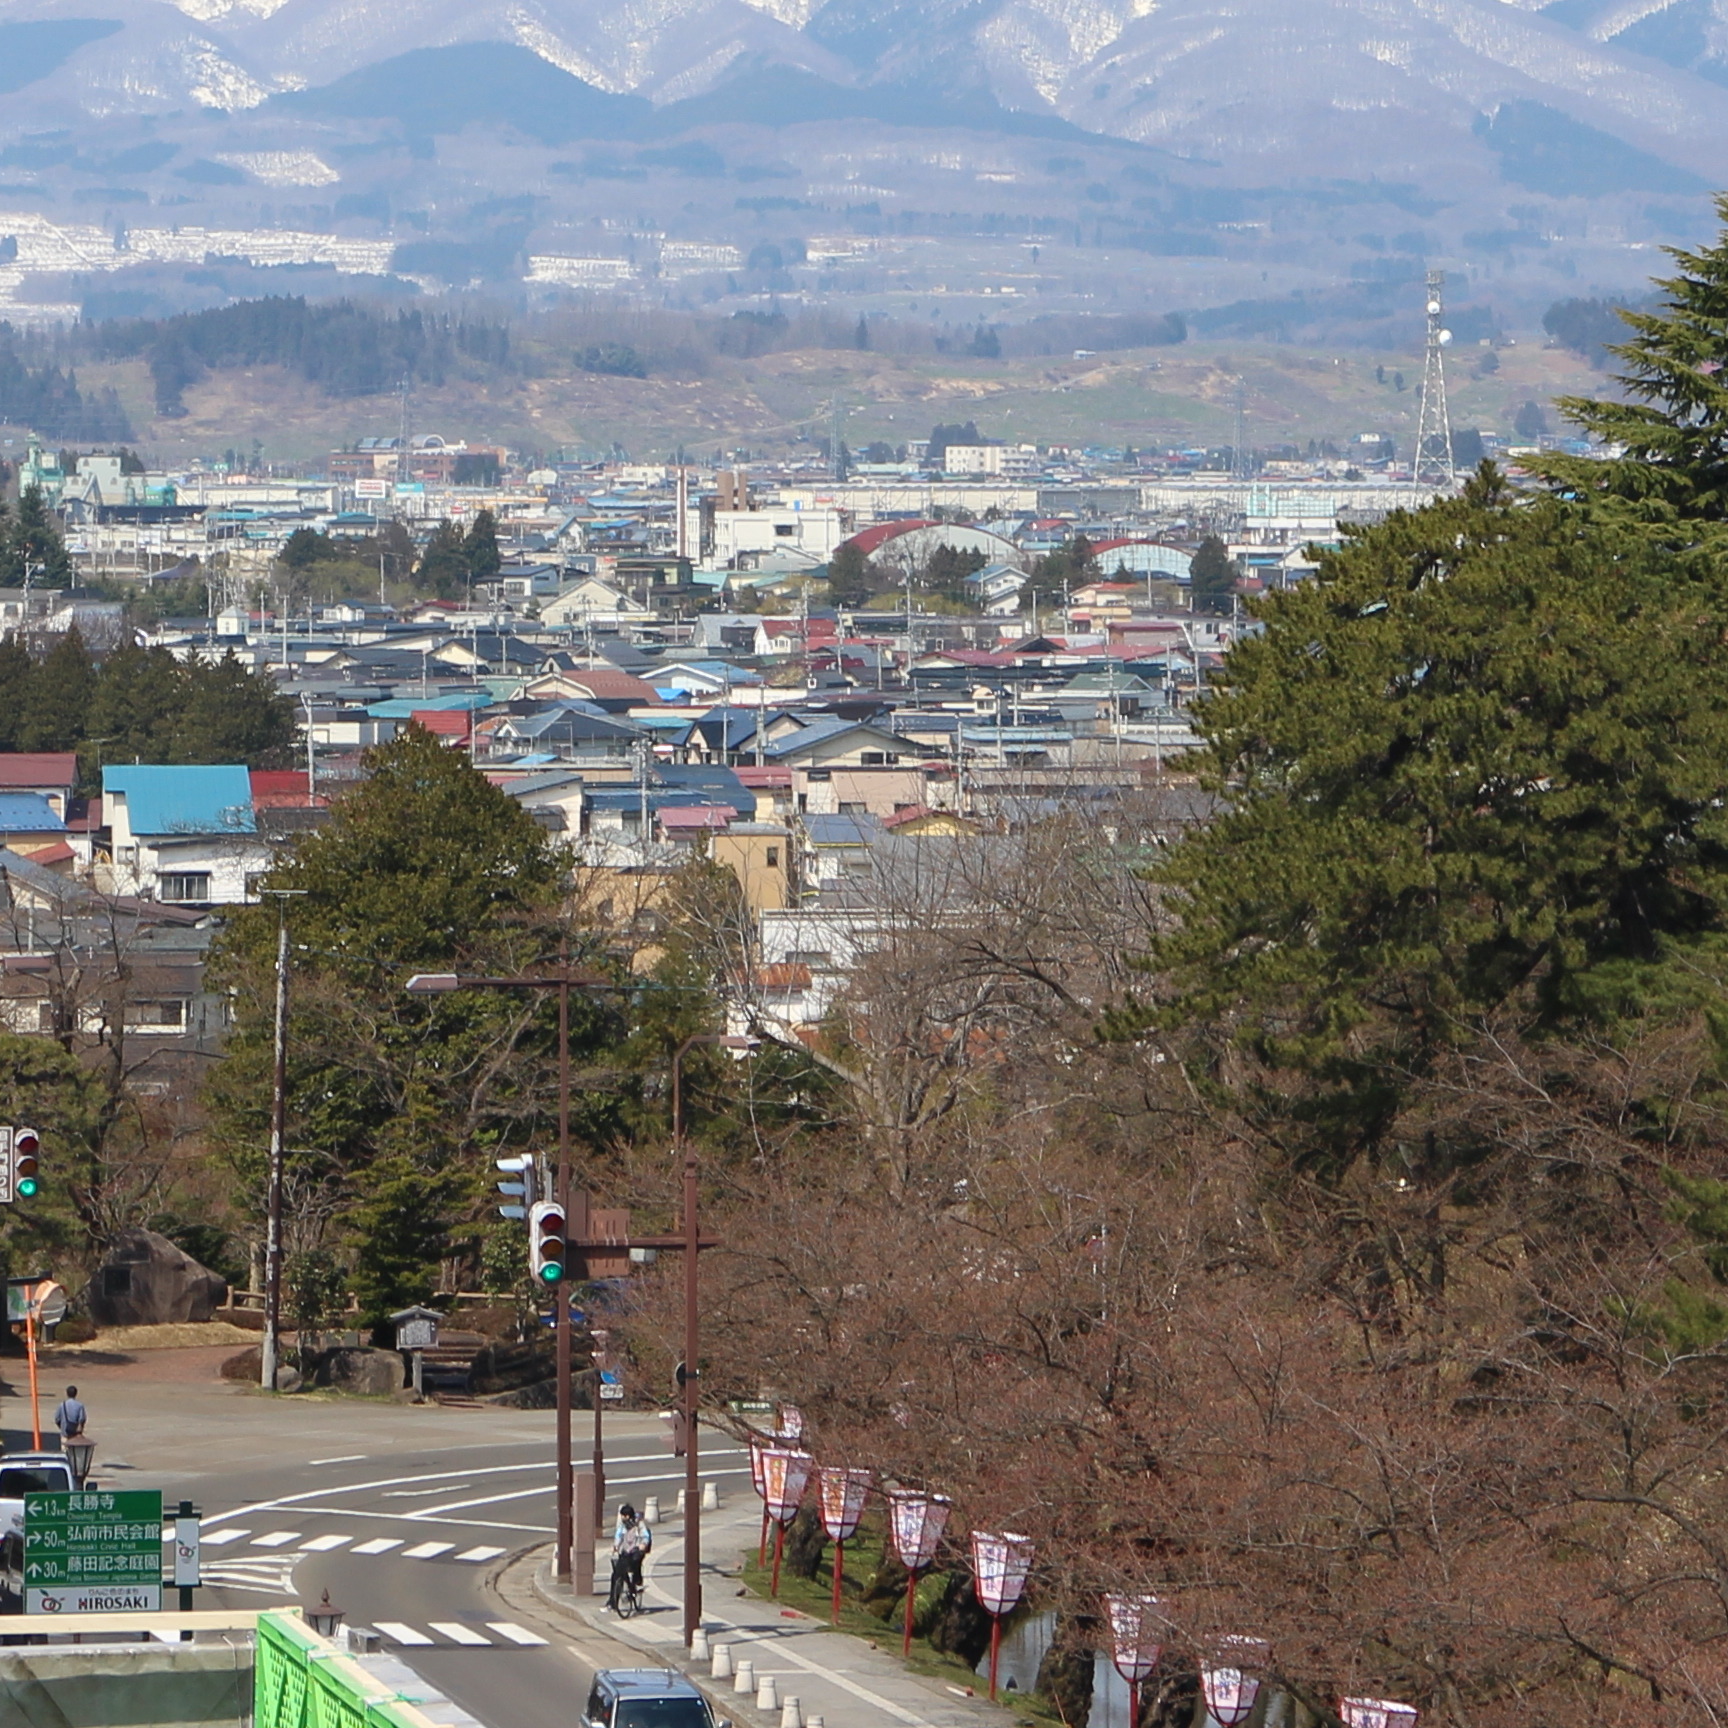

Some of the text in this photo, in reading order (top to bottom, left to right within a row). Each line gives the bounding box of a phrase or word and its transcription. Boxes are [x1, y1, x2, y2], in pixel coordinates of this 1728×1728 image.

[67, 1494, 115, 1511] 長勝寺
[99, 1512, 122, 1521] Temple
[67, 1523, 160, 1541] 弘前市民会館
[66, 1542, 136, 1551] Hirosaki Civic Hall
[67, 1554, 160, 1572] 藤田記念庭園
[78, 1596, 148, 1611] HIROSAKI
